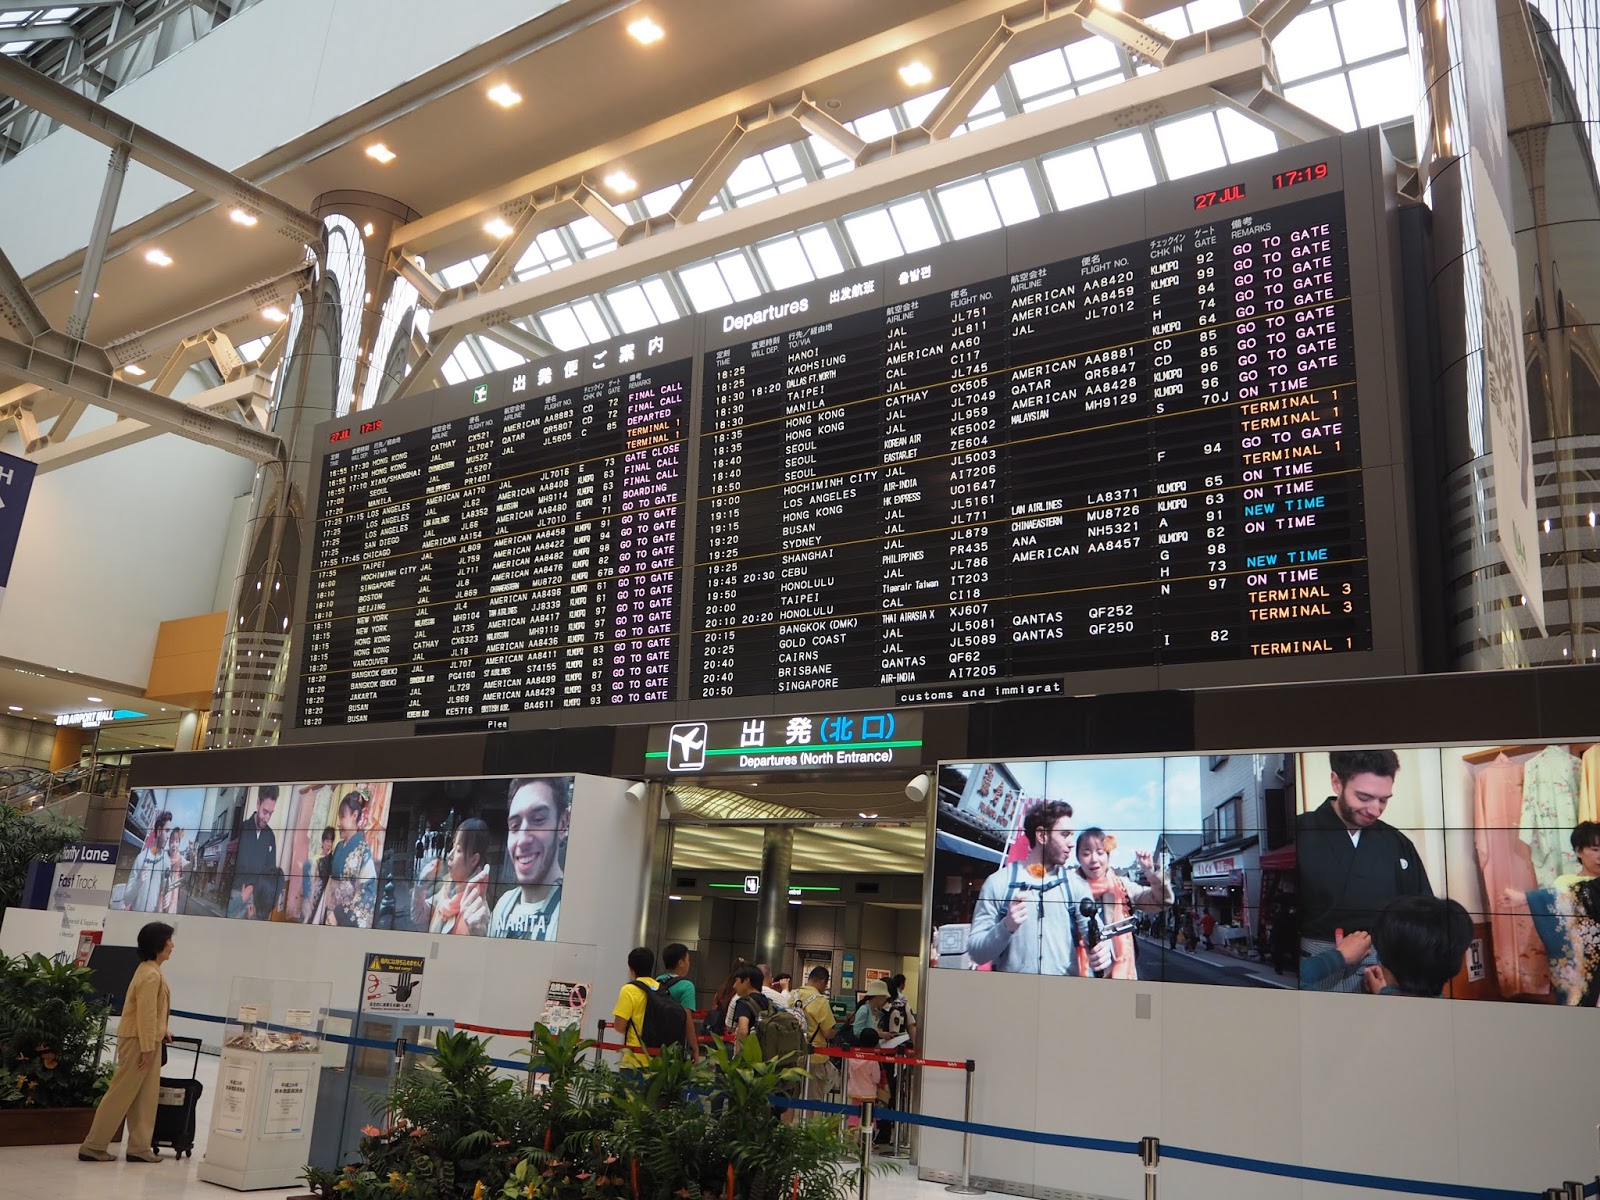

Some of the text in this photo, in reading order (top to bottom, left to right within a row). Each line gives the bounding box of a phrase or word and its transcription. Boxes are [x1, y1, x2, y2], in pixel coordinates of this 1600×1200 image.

[1195, 162, 1327, 209] 27 JUL 17:19
[1231, 221, 1271, 239] REMARKS
[1149, 244, 1182, 259] CHK IN
[1194, 235, 1216, 248] GATE
[898, 265, 931, 286] 출발편
[717, 365, 746, 380] 18:25
[788, 347, 819, 363] HANOI
[887, 326, 908, 339] JAL
[951, 306, 986, 323] JL751
[1011, 284, 1075, 309] AMERICAN
[1083, 271, 1134, 292] AA8420
[1196, 251, 1214, 265] 92
[1232, 242, 1252, 256] GO
[1261, 235, 1281, 249] TO
[1290, 223, 1330, 242] GATE
[829, 279, 875, 304] 出发航班
[950, 290, 993, 308] FLIGHT NO.
[723, 298, 809, 332] Departures
[886, 310, 914, 324] AIRLINE
[750, 344, 779, 358] WILL DEP.
[787, 336, 811, 349] TO/VIA
[716, 357, 730, 367] TIME
[361, 420, 383, 434] 17:19
[372, 456, 389, 467] HONG
[391, 451, 408, 462] KONG
[430, 439, 457, 452] CATHAY
[467, 430, 490, 443] CX521
[502, 417, 541, 434] AMERICAN
[543, 409, 574, 423] AA8883
[582, 404, 594, 414] CD
[608, 397, 619, 407] 72
[628, 389, 656, 402] FINAL
[660, 382, 683, 394] CALL
[712, 468, 742, 482] 18:40
[785, 454, 817, 468] SEOUL
[884, 436, 907, 449] KOREAN
[909, 433, 922, 445] AIR
[950, 419, 996, 437] KE5002
[1085, 392, 1137, 412] MH9129
[1201, 376, 1219, 390] 96
[1238, 369, 1258, 383] GO
[1267, 364, 1288, 377] TO
[1297, 354, 1338, 372] GATE
[711, 389, 1338, 508] 19:00 HOCHIMINH CITY JAL JL5003 TERMINAL 1
[366, 509, 380, 519] LOS
[381, 502, 411, 515] ANGELES
[425, 491, 460, 506] AMERICAN
[462, 485, 486, 498] AA170
[498, 480, 513, 490] JAL
[540, 467, 570, 481] JL7016
[578, 463, 585, 473] E
[604, 457, 615, 467] 73
[624, 450, 647, 463] GATE
[651, 443, 680, 457] CLOSE
[708, 496, 1325, 588] 19:45 20:30 CEBU PHILIPPINES PR435 ANA NH5321 A 91 NEW TIME
[705, 603, 736, 615] 20:00
[780, 592, 819, 606] TAIPEI
[951, 572, 989, 586] IT203
[1160, 549, 1170, 561] G
[1207, 543, 1226, 555] 98
[704, 582, 1352, 657] 20:25 GOLD COAST JAL JL5081 QANTAS QF252 TERMINAL 3
[349, 691, 378, 701] JAKARTA
[409, 687, 422, 696] JAL
[447, 682, 471, 692] JL729
[483, 678, 522, 689] AMERICAN
[525, 674, 556, 685] AA8499
[591, 670, 603, 680] 87
[612, 668, 625, 678] GO
[629, 666, 642, 676] TO
[645, 663, 670, 675] GATE
[702, 665, 997, 697] 20:50 SINGAPORE AIR-INDIA AI7205
[901, 681, 1060, 702] customs and immigrat
[487, 720, 507, 729] Plea
[739, 748, 893, 768] Departures (North Entrance)
[81, 846, 109, 861] Lane
[58, 873, 98, 889] Fast Track
[496, 914, 546, 934] NARITA
